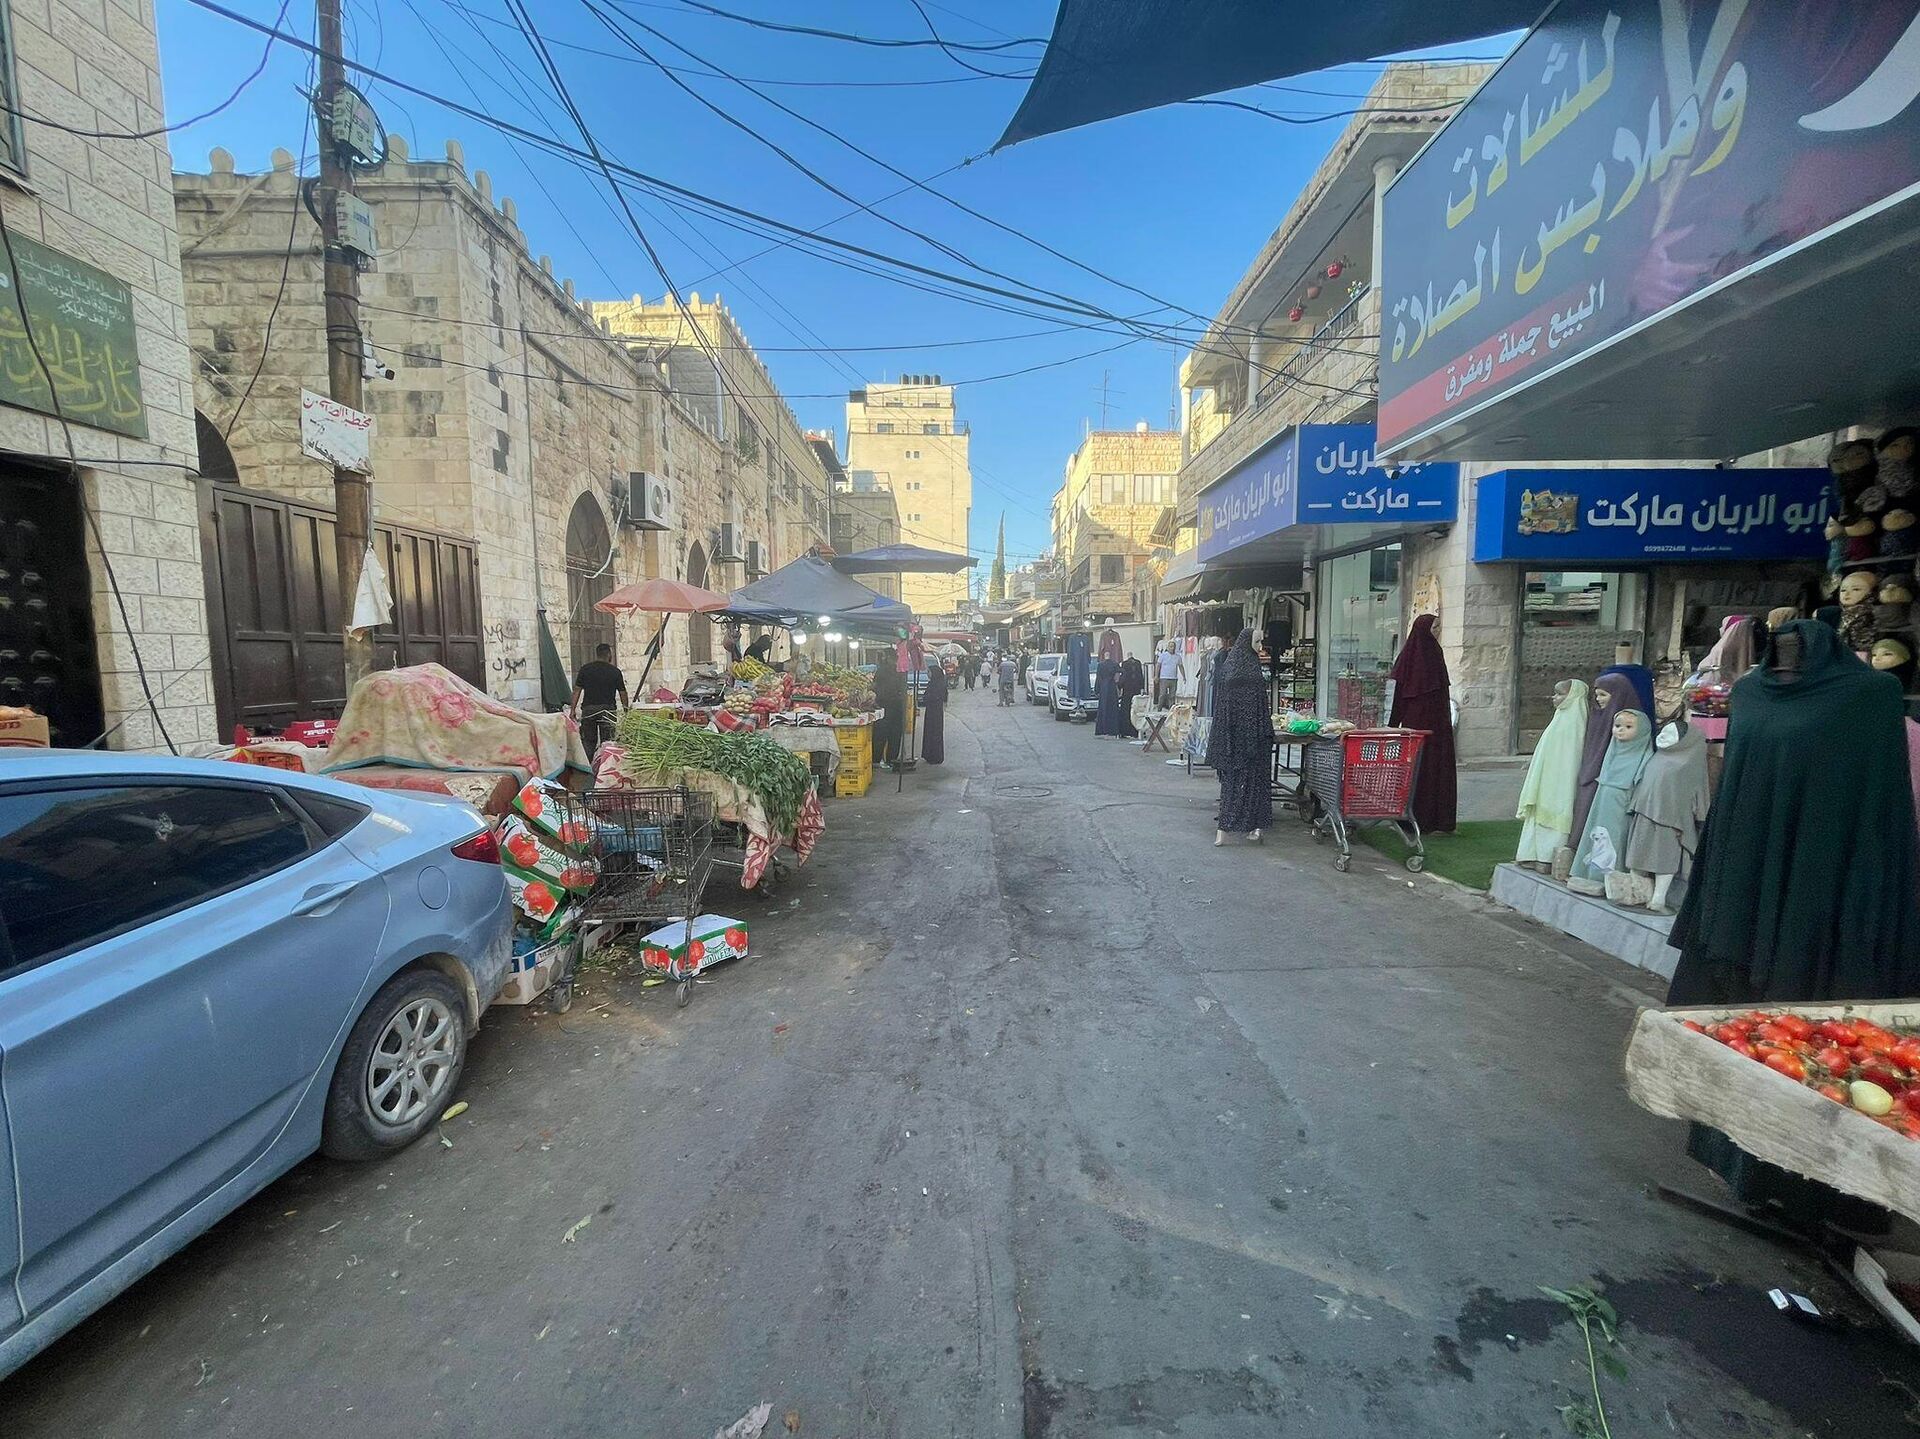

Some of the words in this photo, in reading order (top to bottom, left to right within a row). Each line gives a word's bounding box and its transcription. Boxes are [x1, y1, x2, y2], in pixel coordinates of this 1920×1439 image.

[1446, 9, 1622, 230] للشالات
[1515, 61, 1748, 295] وملابس
[1391, 226, 1500, 363] الصلاة
[1547, 277, 1606, 350] البيع
[1498, 324, 1543, 364] جملة
[1444, 352, 1493, 402] ومفرق
[1242, 470, 1272, 521] الريان
[1271, 449, 1292, 507] أبو
[1340, 487, 1410, 515] ماركت
[1214, 494, 1241, 531] ماركت
[1587, 492, 1684, 536] ماركت
[1691, 493, 1776, 535] الريان
[1782, 486, 1830, 533] أبو
